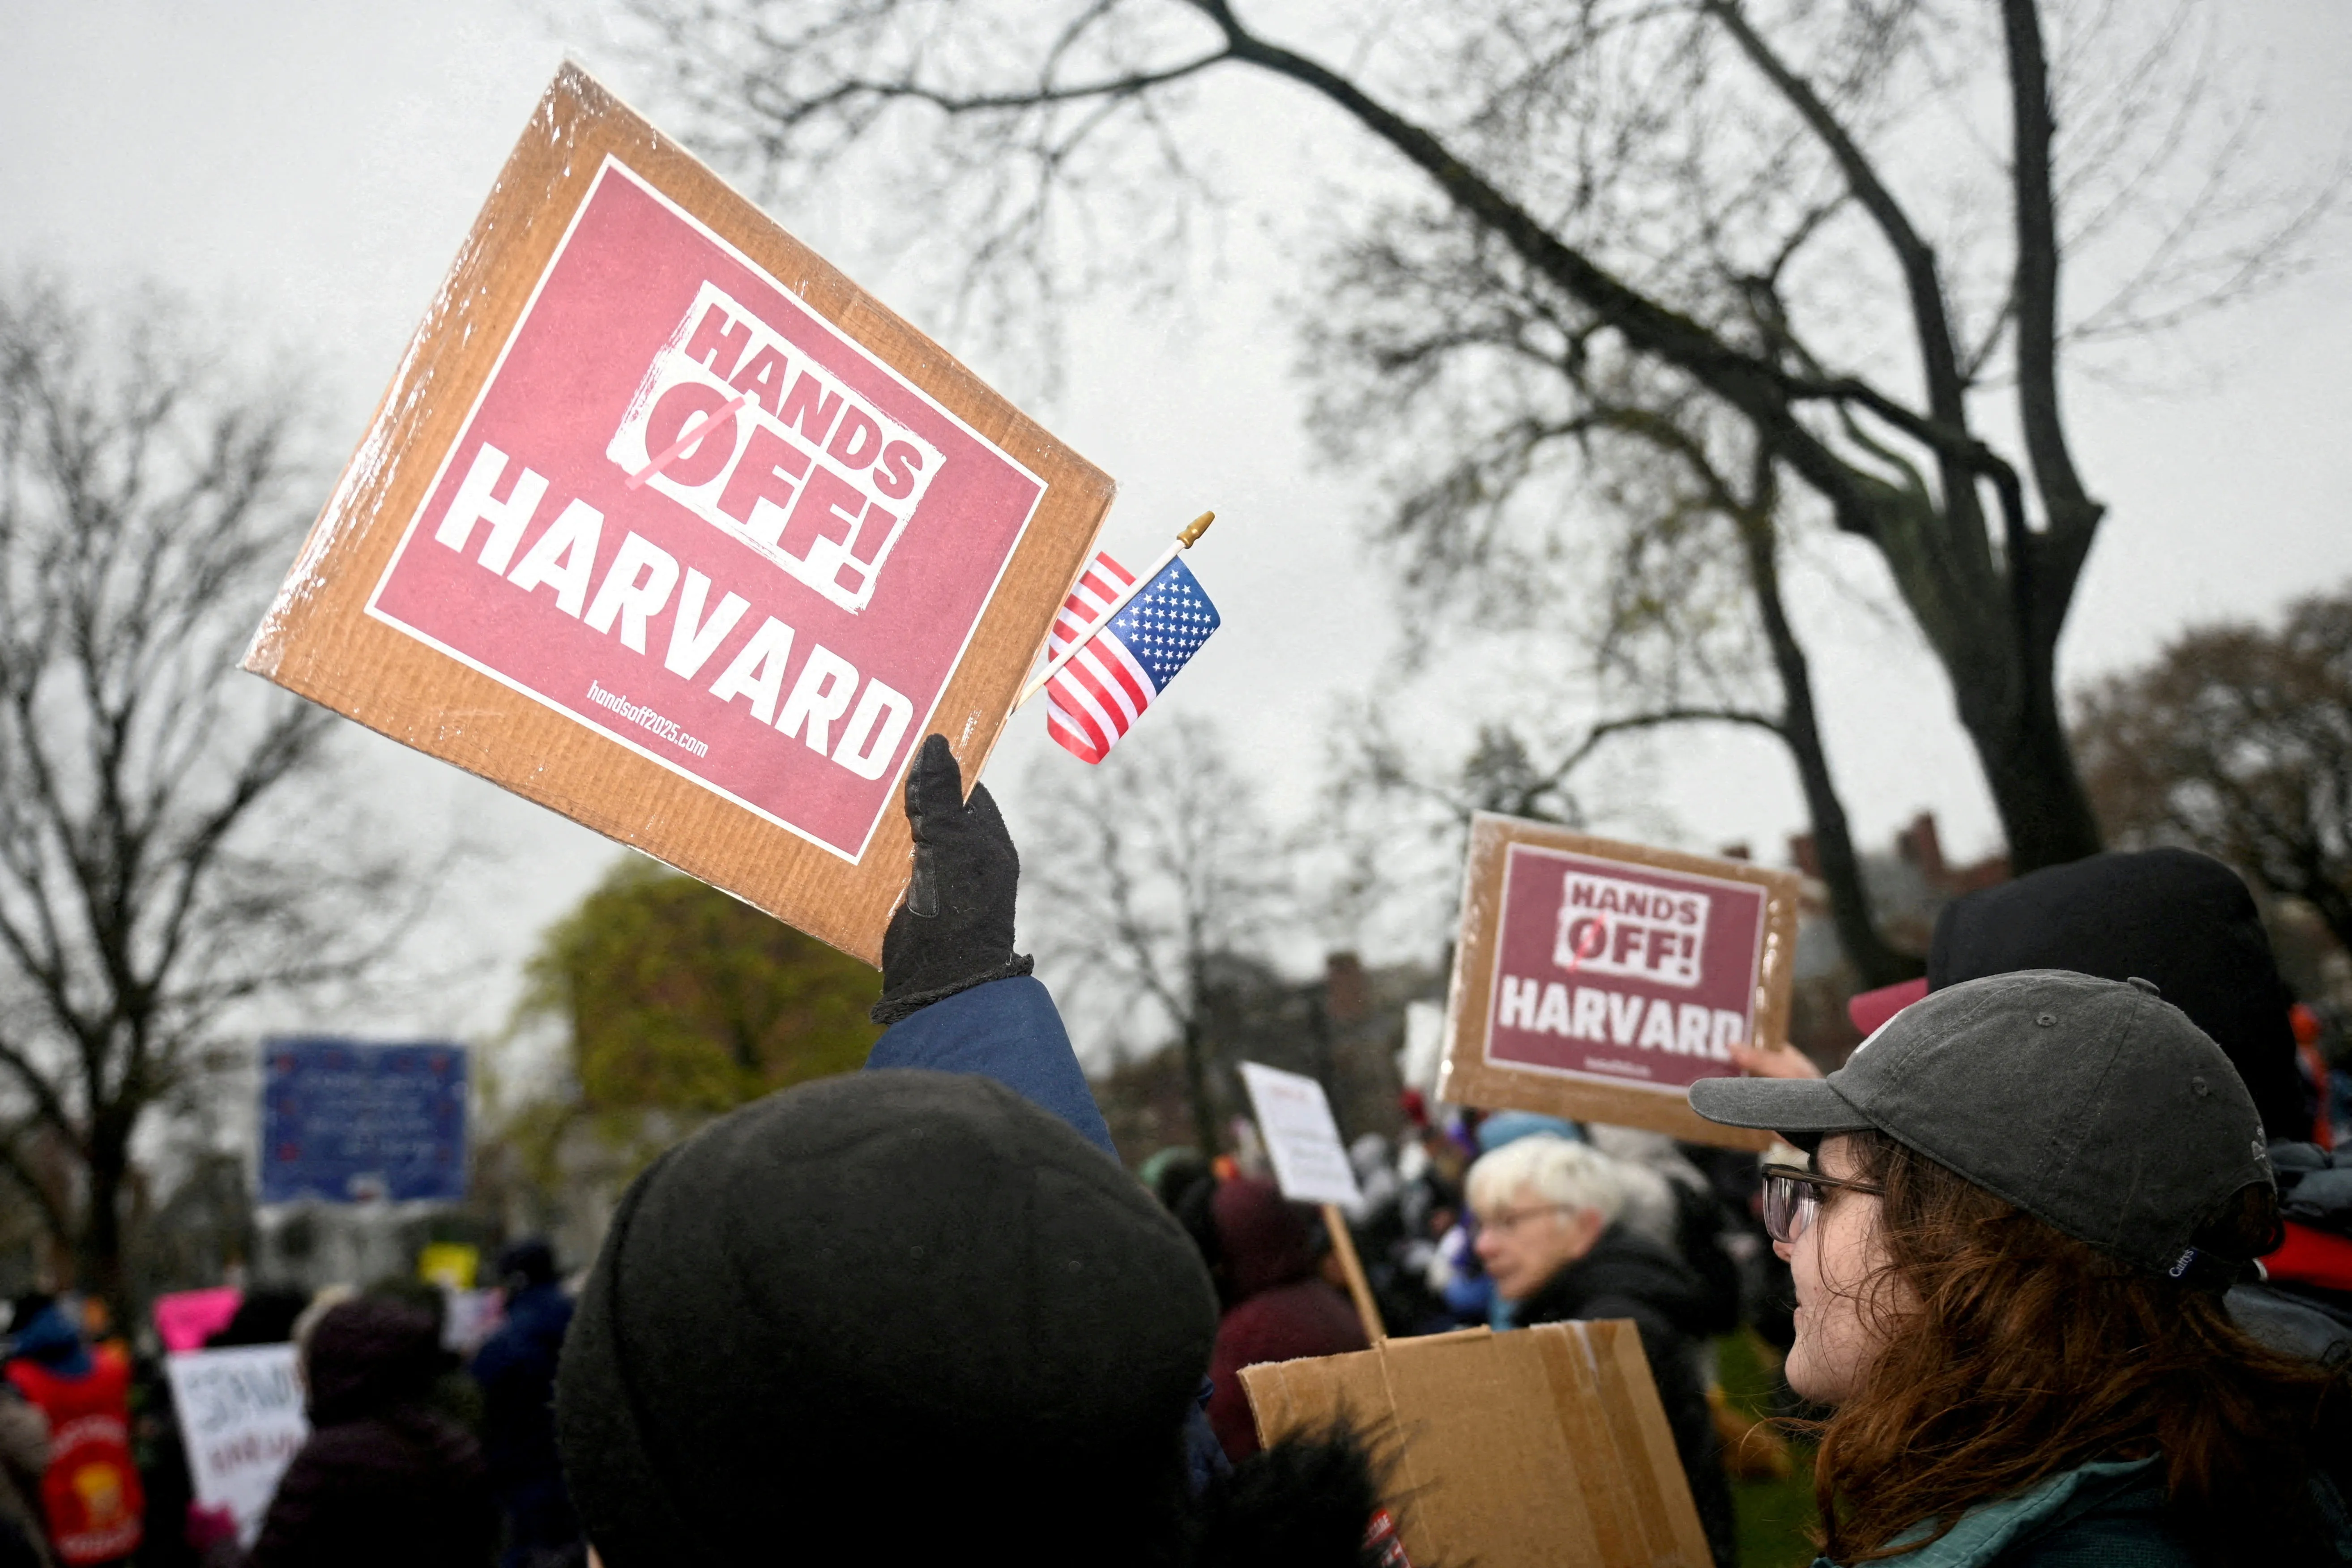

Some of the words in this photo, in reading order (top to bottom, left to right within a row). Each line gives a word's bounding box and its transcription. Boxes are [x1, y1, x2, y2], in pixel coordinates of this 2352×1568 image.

[684, 303, 923, 499] HANDS
[435, 442, 913, 781] HARVARD
[586, 680, 709, 758] handsoff2025.com
[1571, 881, 1696, 925] HANDS
[1499, 975, 1744, 1061] HARVARD
